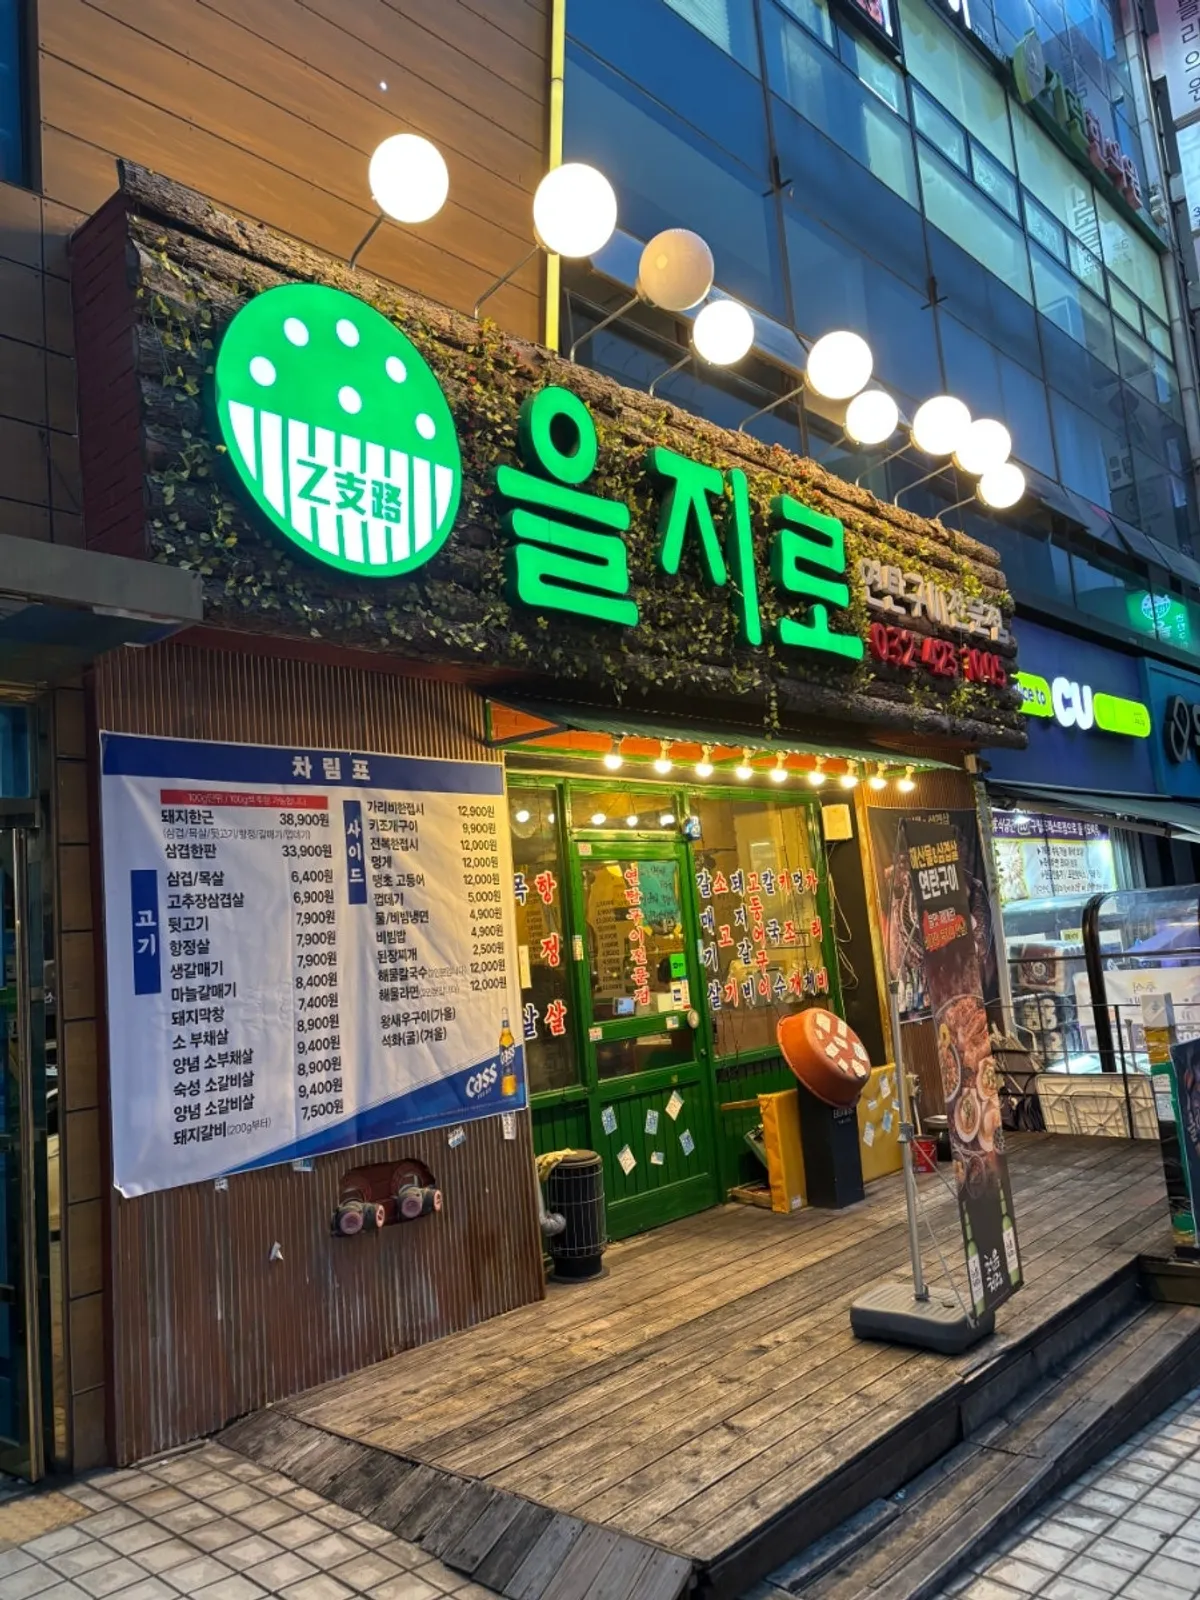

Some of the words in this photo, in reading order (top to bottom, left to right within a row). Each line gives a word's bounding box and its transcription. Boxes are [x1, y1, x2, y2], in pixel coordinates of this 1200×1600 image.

[492, 385, 864, 661] 을지로
[1052, 676, 1094, 730] CU
[161, 809, 214, 825] 돼지한근
[279, 813, 330, 827] 38,900원
[458, 806, 495, 817] 12,900원
[369, 820, 418, 833] 키조개구이
[462, 823, 496, 834] 9,900원
[165, 844, 217, 859] 삼겹한판
[282, 845, 333, 859] 33,900원
[347, 819, 364, 883] 사이드
[370, 838, 419, 852] 전복한접시
[460, 839, 497, 852] 12,000원
[371, 855, 392, 869] 멍게
[462, 856, 499, 869] 12,000원
[167, 871, 225, 887] 삼겹/목살
[291, 870, 334, 884] 6,400원
[373, 874, 393, 888] 땡초
[396, 874, 425, 888] 고등어
[463, 874, 500, 886] 12,000원
[918, 864, 960, 900] 연탄구이
[167, 893, 245, 909] 고추장삼겹살
[293, 890, 334, 905] 6,900원
[374, 893, 404, 907] 껍데기
[468, 890, 502, 902] 5,000원
[168, 916, 209, 933] 뒷고기
[296, 910, 335, 925] 7,900원
[375, 910, 429, 926] 물/비빔냉면
[469, 908, 502, 920] 4,900원
[761, 868, 787, 993] 칼국수
[135, 910, 156, 955] 고기
[170, 938, 210, 956] 항정살
[296, 932, 336, 948] 7,900원
[376, 930, 406, 943] 비빔밥
[471, 924, 503, 937] 4,900원
[624, 863, 651, 1006] 연탄구이전문점
[696, 868, 722, 1011] 갈매기살
[711, 871, 739, 1008] 소고기
[730, 868, 756, 1001] 돼지갈비
[747, 871, 771, 1001] 고등어구이
[805, 871, 830, 993] 가리비
[170, 960, 223, 980] 생갈매기
[296, 951, 337, 968] 7,900원
[377, 948, 417, 964] 된장찌개
[472, 942, 504, 956] 2,500원
[470, 959, 505, 973] 12,000원
[535, 870, 567, 1036] 항정살
[171, 982, 237, 1002] 마늘갈매기
[295, 972, 338, 989] 8,400원
[470, 977, 507, 991] 12,000원
[171, 1006, 225, 1027] 돼지막창
[298, 993, 338, 1010] 7,400원
[380, 1007, 456, 1030] 왕새우구이(가을)
[172, 1035, 186, 1050] 소
[190, 1028, 229, 1047] 부채살
[297, 1014, 339, 1032] 8,900원
[382, 1027, 447, 1048] 석화(굴)(겨울)
[173, 1056, 200, 1075] 양념
[204, 1048, 254, 1070] 소부채살
[297, 1035, 340, 1055] 9,400원
[173, 1079, 201, 1097] 숙성
[205, 1070, 255, 1093] 소갈비살
[297, 1056, 342, 1077] 8,900원
[465, 1062, 498, 1099] Cass
[174, 1102, 201, 1122] 양념
[205, 1094, 255, 1117] 소갈비살
[298, 1078, 343, 1098] 9,400원
[301, 1099, 344, 1121] 7,500원
